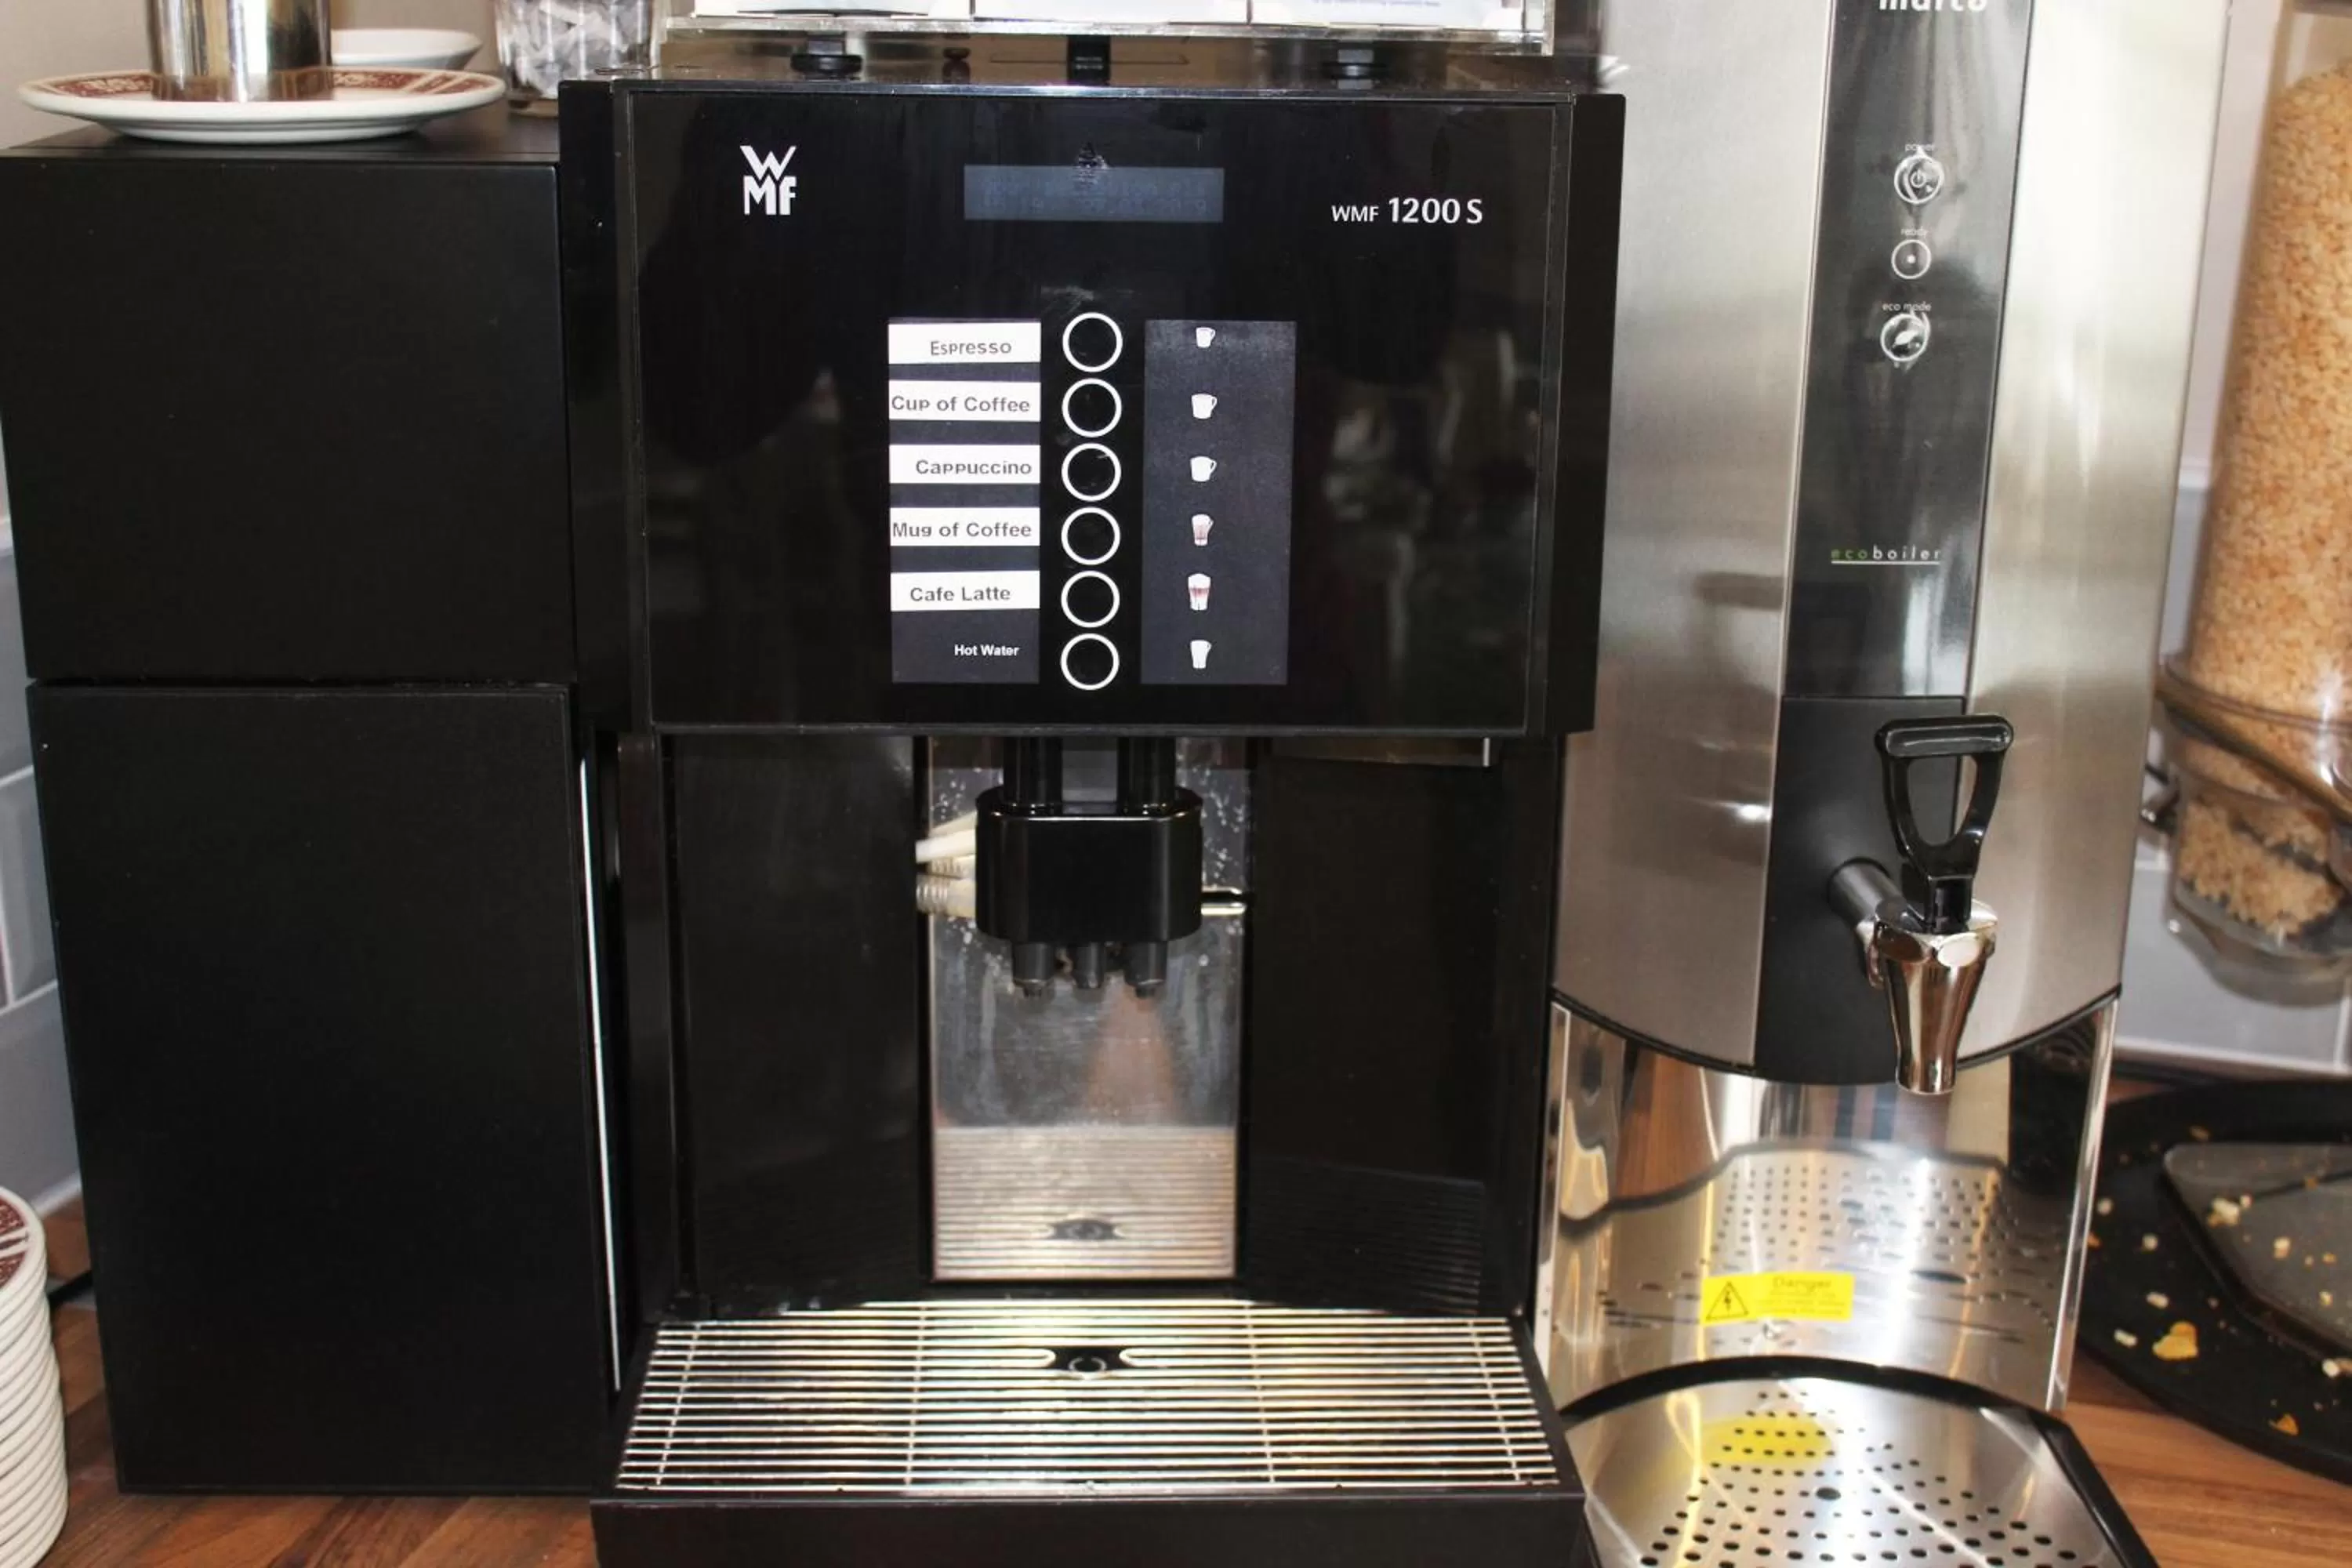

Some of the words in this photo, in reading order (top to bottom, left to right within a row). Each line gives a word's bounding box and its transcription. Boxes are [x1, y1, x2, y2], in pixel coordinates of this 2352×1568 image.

[1331, 205, 1379, 222] WMF
[1882, 303, 1901, 311] eco
[930, 340, 1012, 356] Espresso
[891, 395, 930, 412] Cup
[937, 397, 957, 412] of
[964, 397, 1030, 412] Coffee
[916, 459, 1032, 475] Cappuccino
[892, 522, 932, 537] Mug
[938, 522, 960, 537] of
[966, 522, 1032, 537] Coffee
[910, 587, 954, 601] Cafe
[962, 586, 1011, 601] Latte
[954, 644, 978, 656] Hot
[980, 644, 1019, 656] Water
